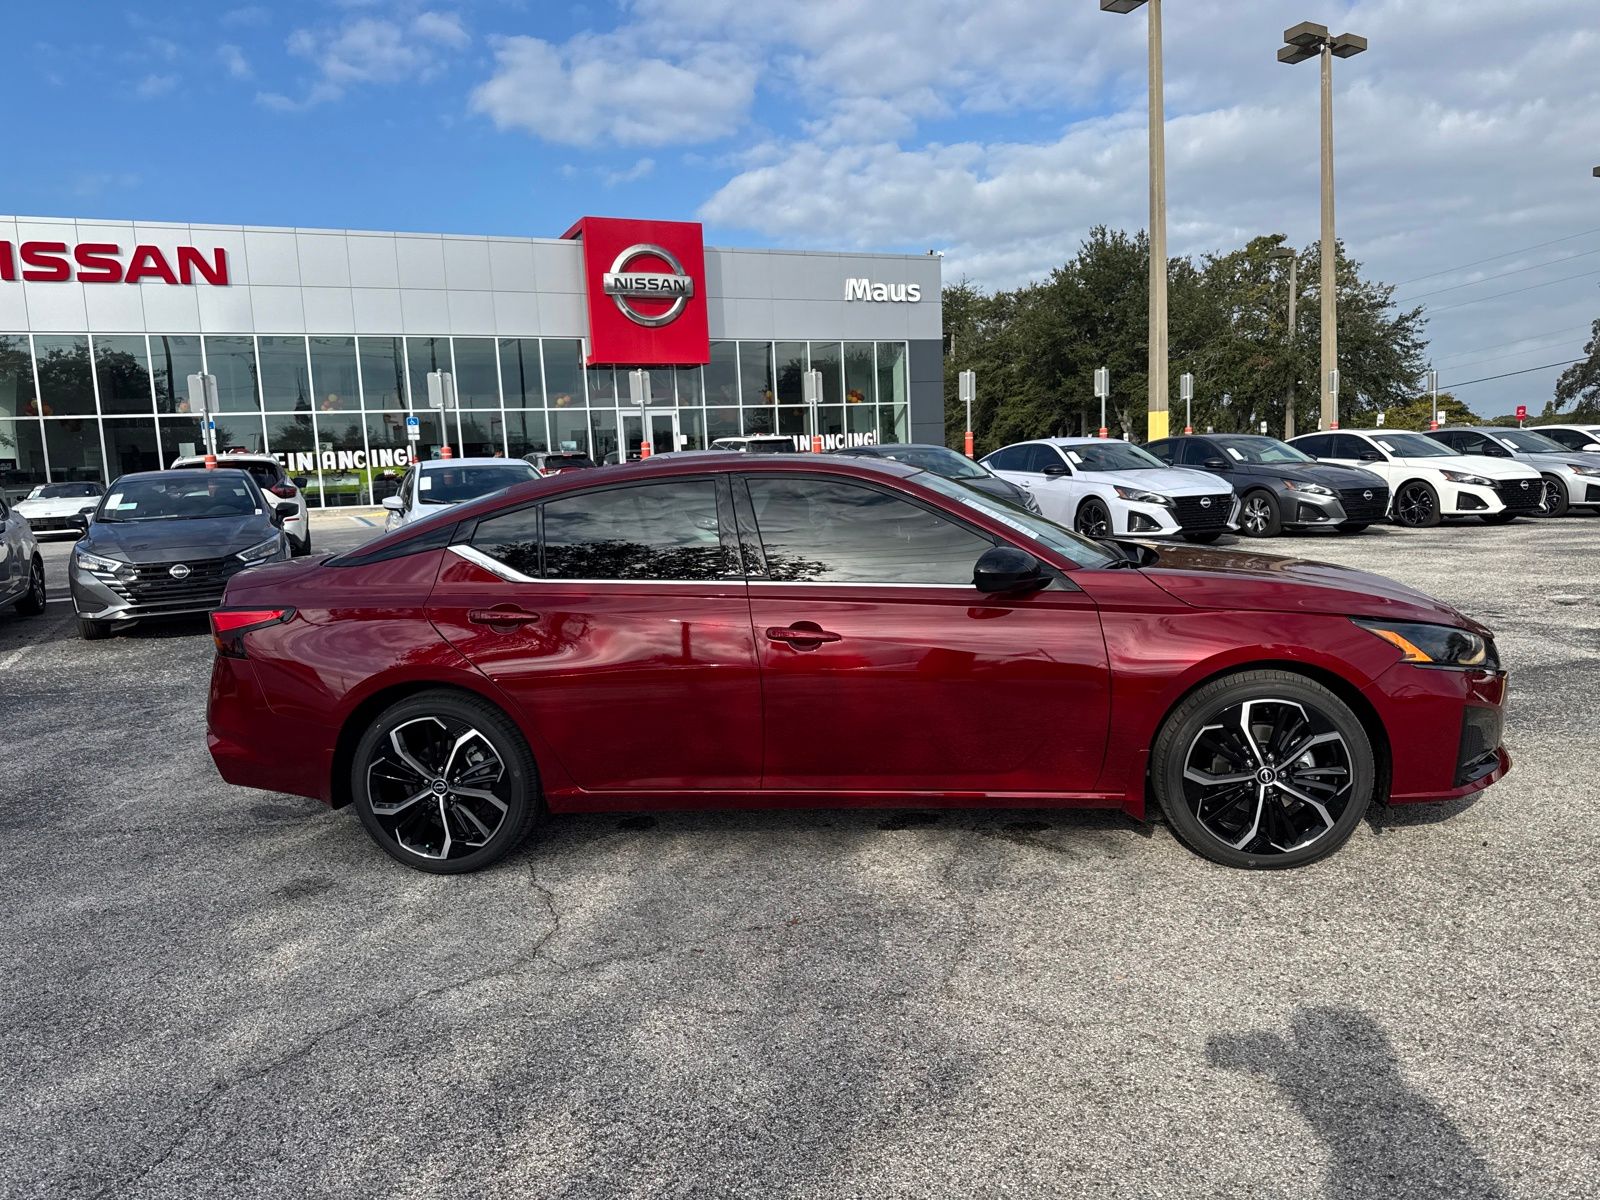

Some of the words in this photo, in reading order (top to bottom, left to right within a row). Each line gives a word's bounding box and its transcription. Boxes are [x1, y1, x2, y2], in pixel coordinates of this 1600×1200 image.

[0, 241, 229, 286] ISSAN
[613, 277, 686, 291] NISSAN
[845, 278, 921, 302] Maus
